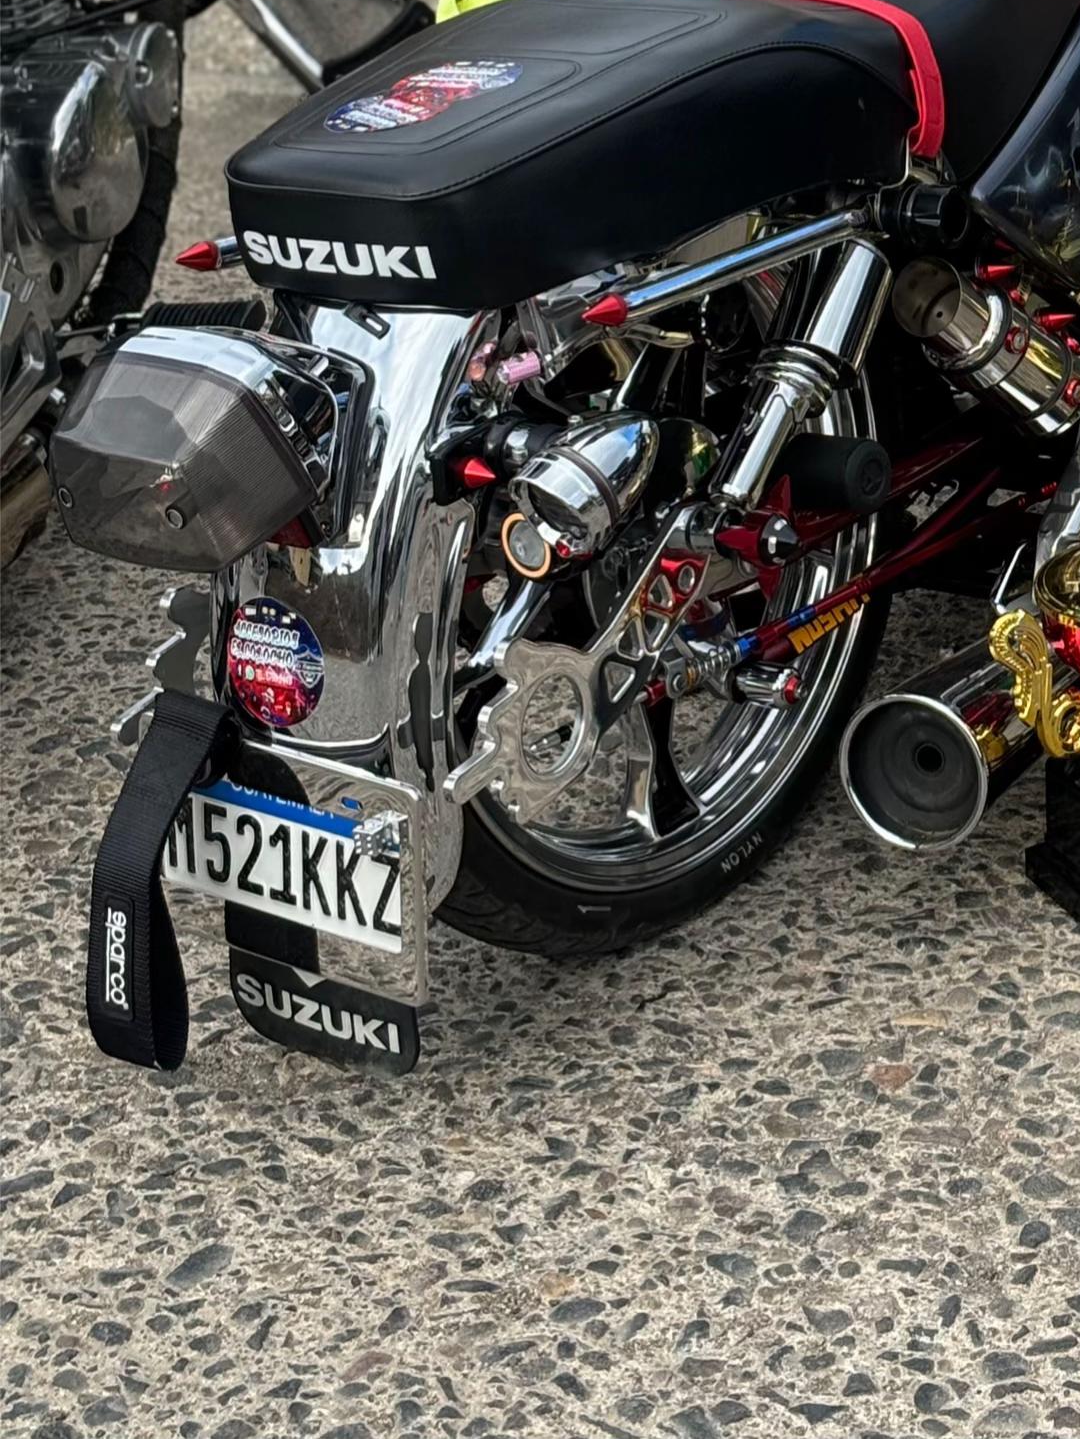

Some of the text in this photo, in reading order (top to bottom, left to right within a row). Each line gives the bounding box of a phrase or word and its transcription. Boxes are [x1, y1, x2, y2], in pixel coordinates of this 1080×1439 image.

[243, 230, 437, 279] SUZUKI
[721, 832, 762, 873] NYLON
[104, 907, 128, 1006] sparco
[236, 973, 400, 1054] SUZUKI
